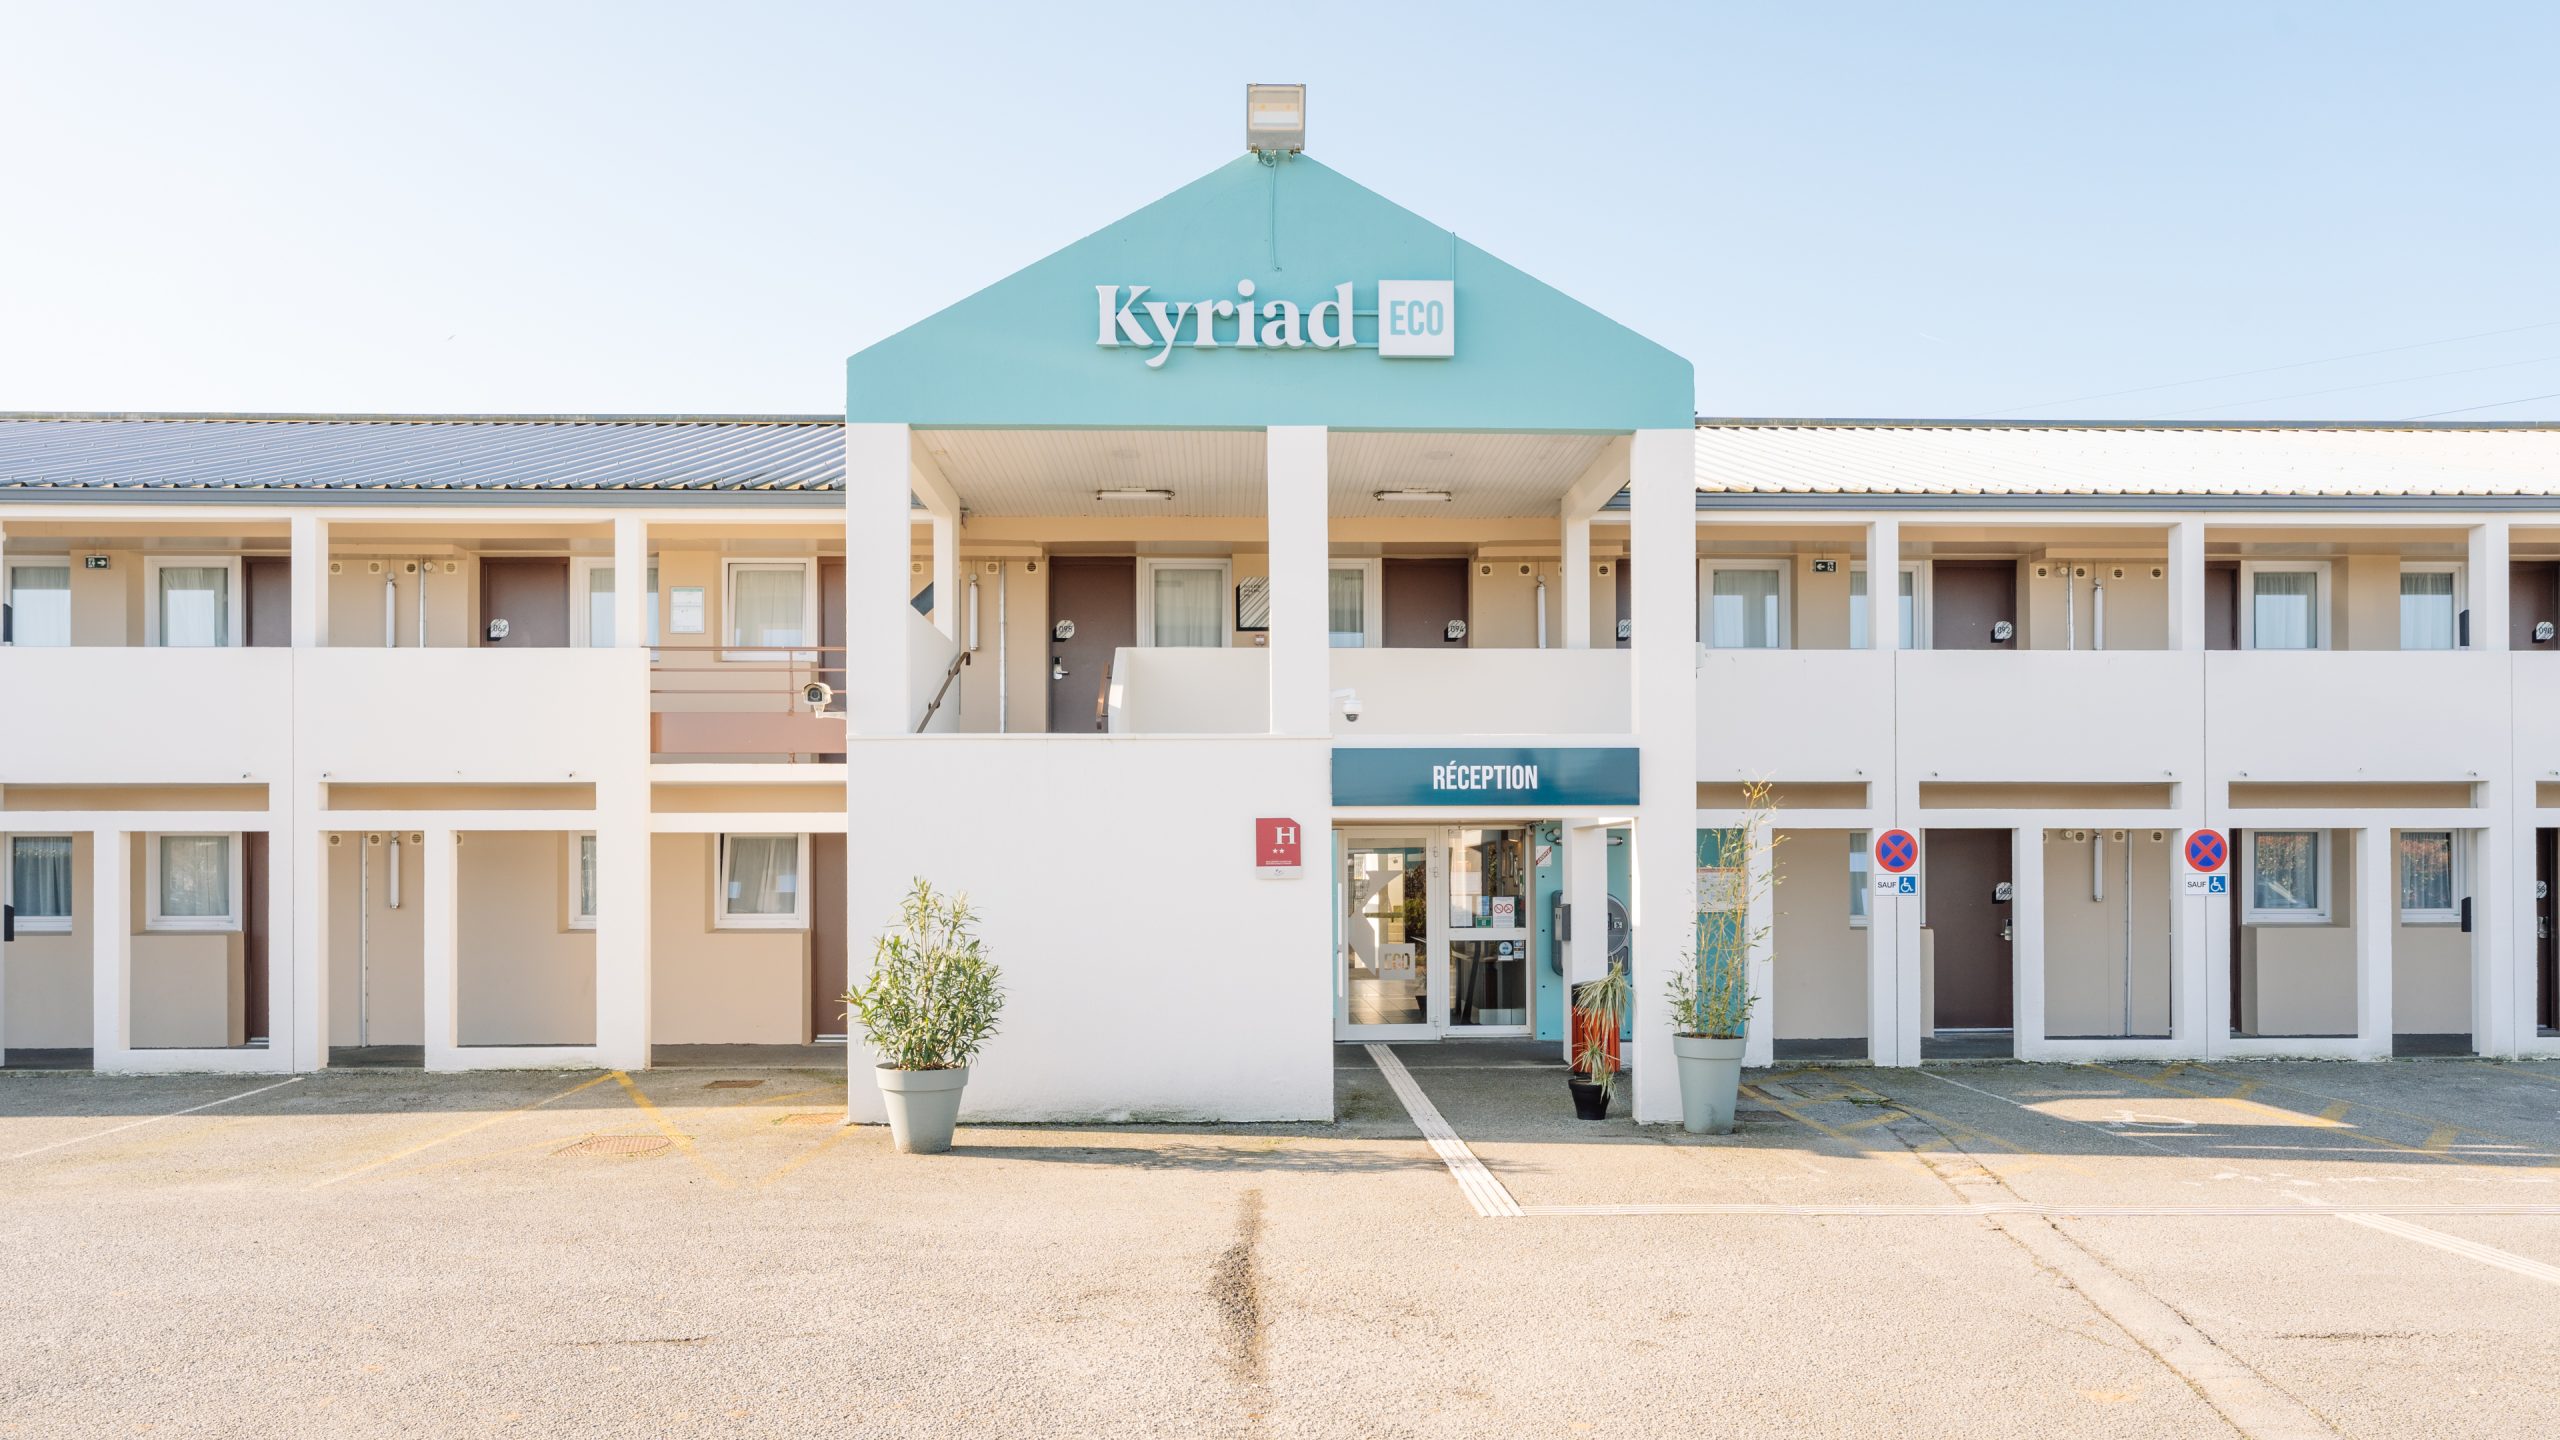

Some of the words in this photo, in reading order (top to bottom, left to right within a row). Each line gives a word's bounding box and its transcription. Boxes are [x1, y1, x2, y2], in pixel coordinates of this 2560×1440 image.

[1095, 278, 1358, 369] Kyriad
[1389, 300, 1444, 337] ECO
[1432, 760, 1538, 790] RÉCEPTION
[1275, 826, 1297, 845] H
[1877, 881, 1897, 889] SAUF
[1383, 952, 1411, 971] ECO
